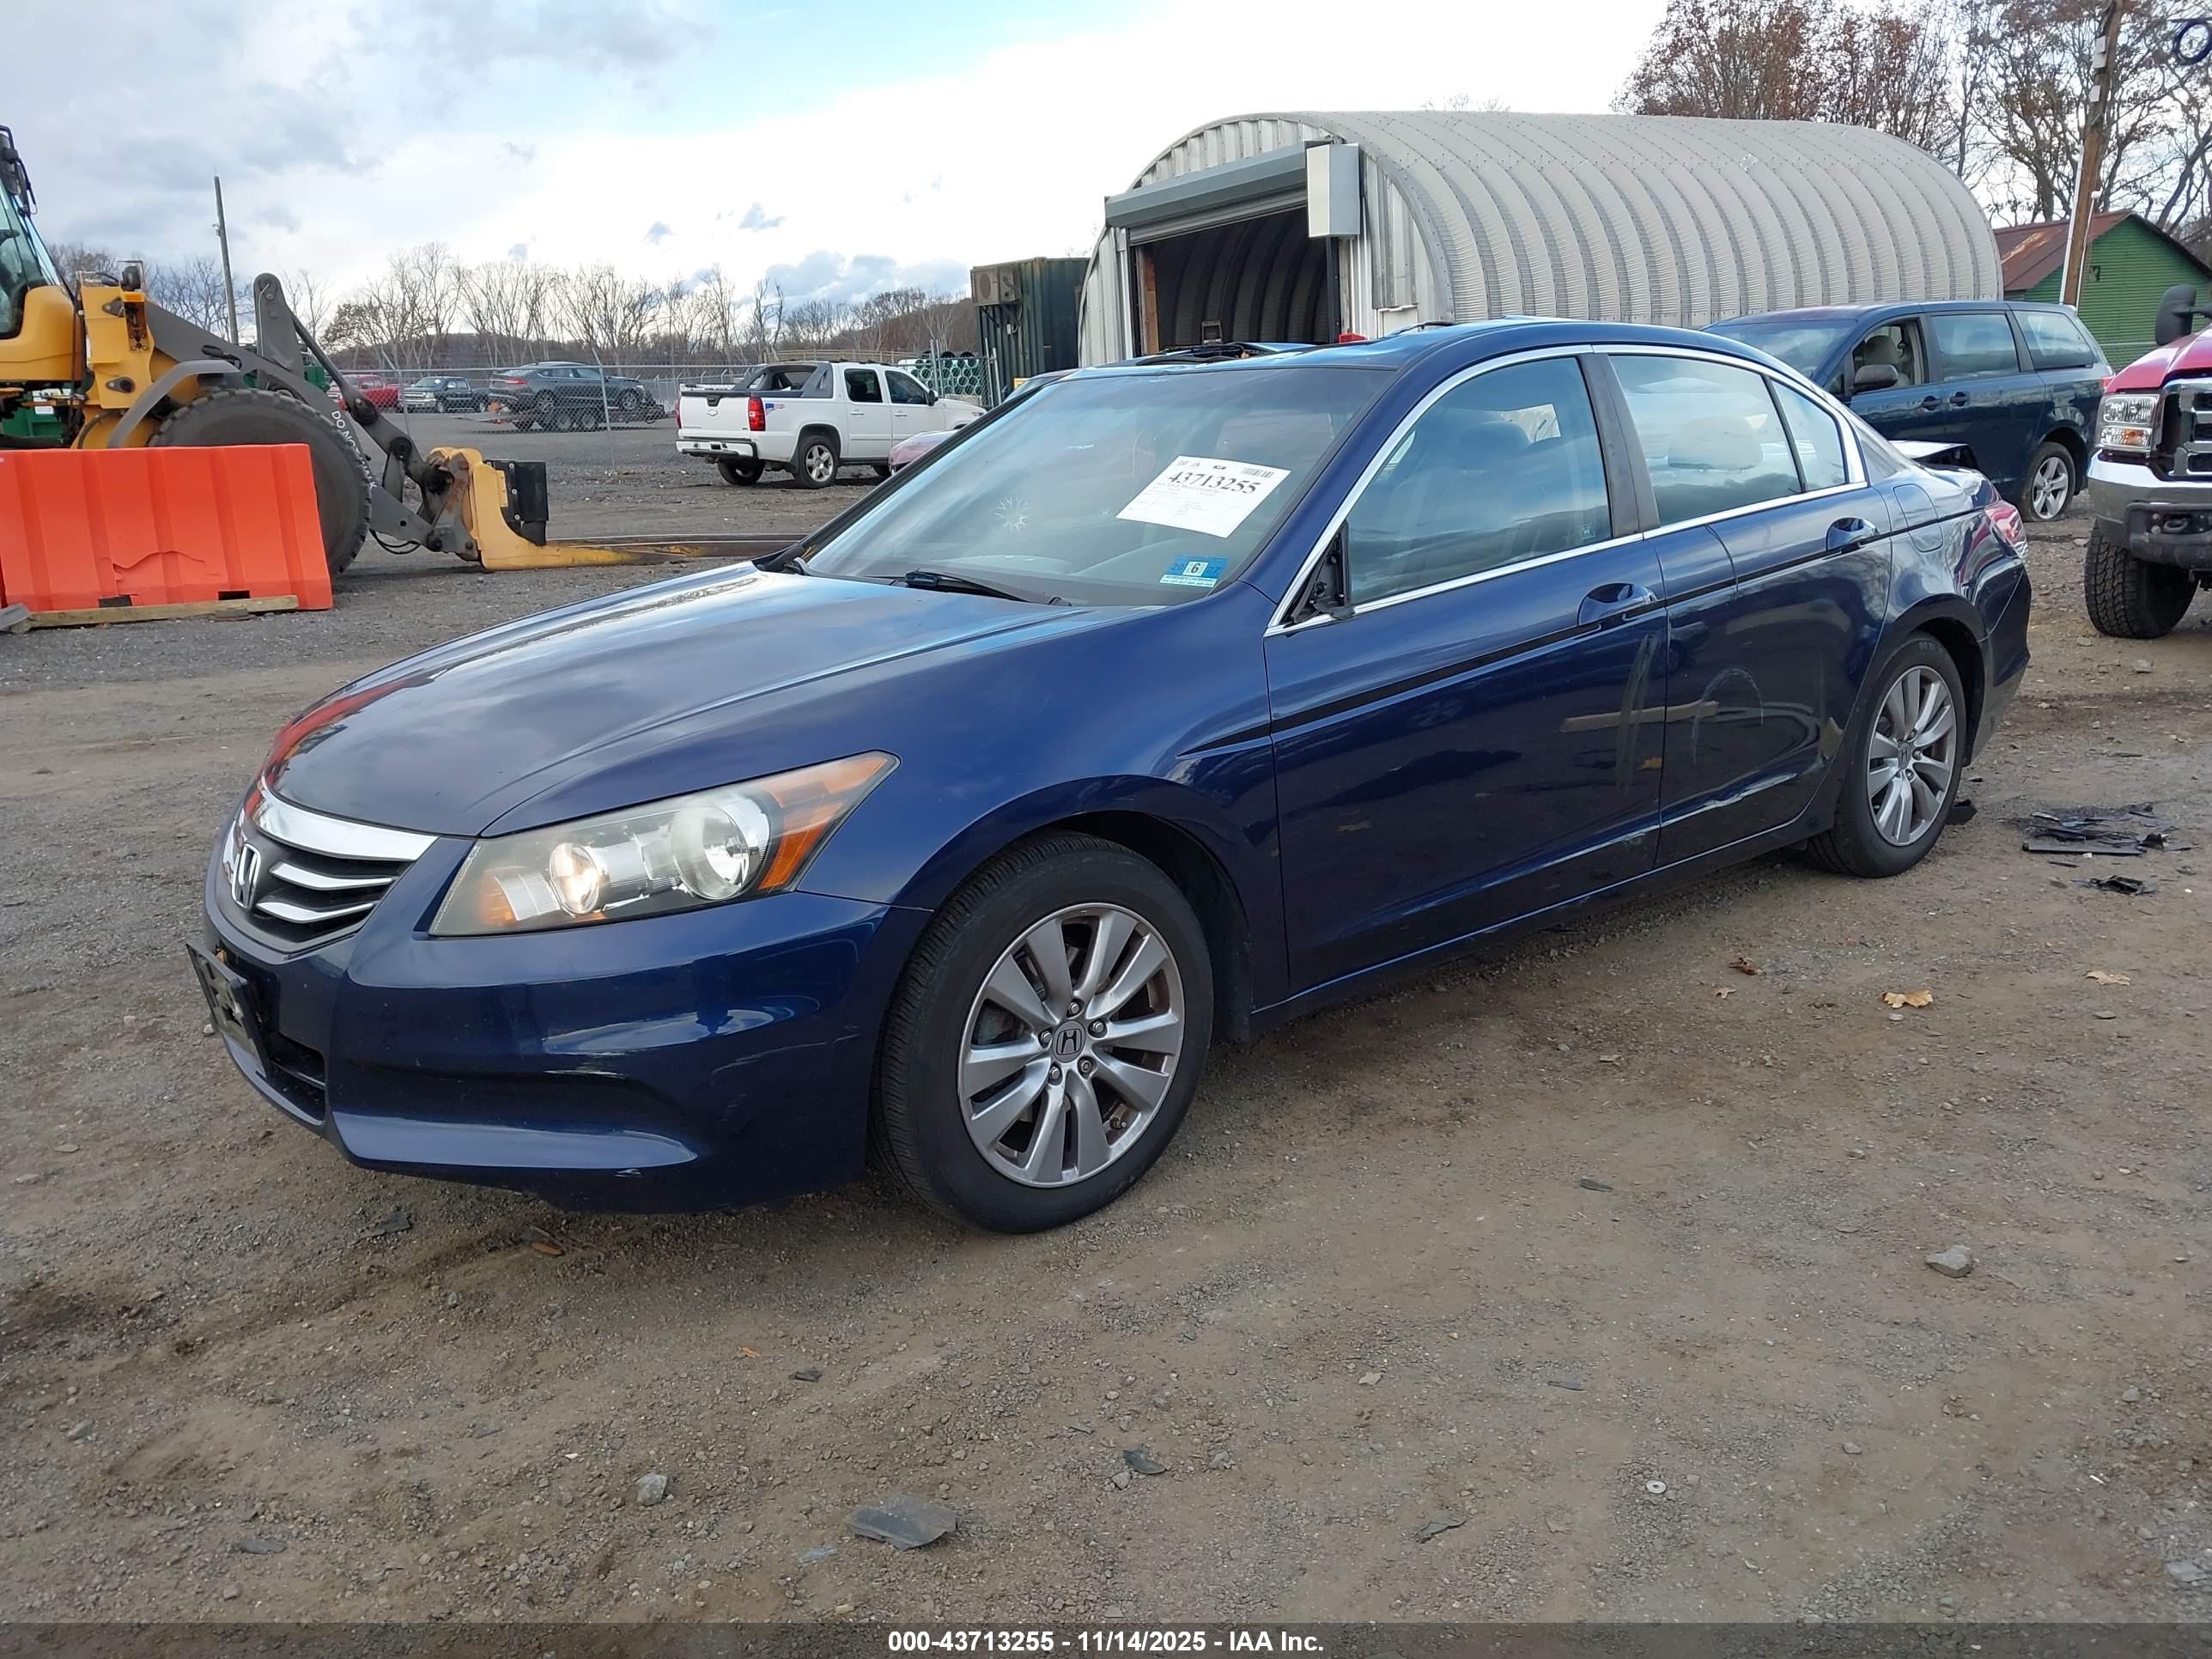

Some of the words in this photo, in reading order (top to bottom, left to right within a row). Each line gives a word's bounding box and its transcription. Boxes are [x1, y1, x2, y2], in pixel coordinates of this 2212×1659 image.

[331, 411, 345, 428] DO
[1168, 471, 1262, 494] 43713255
[1191, 562, 1200, 574] 6
